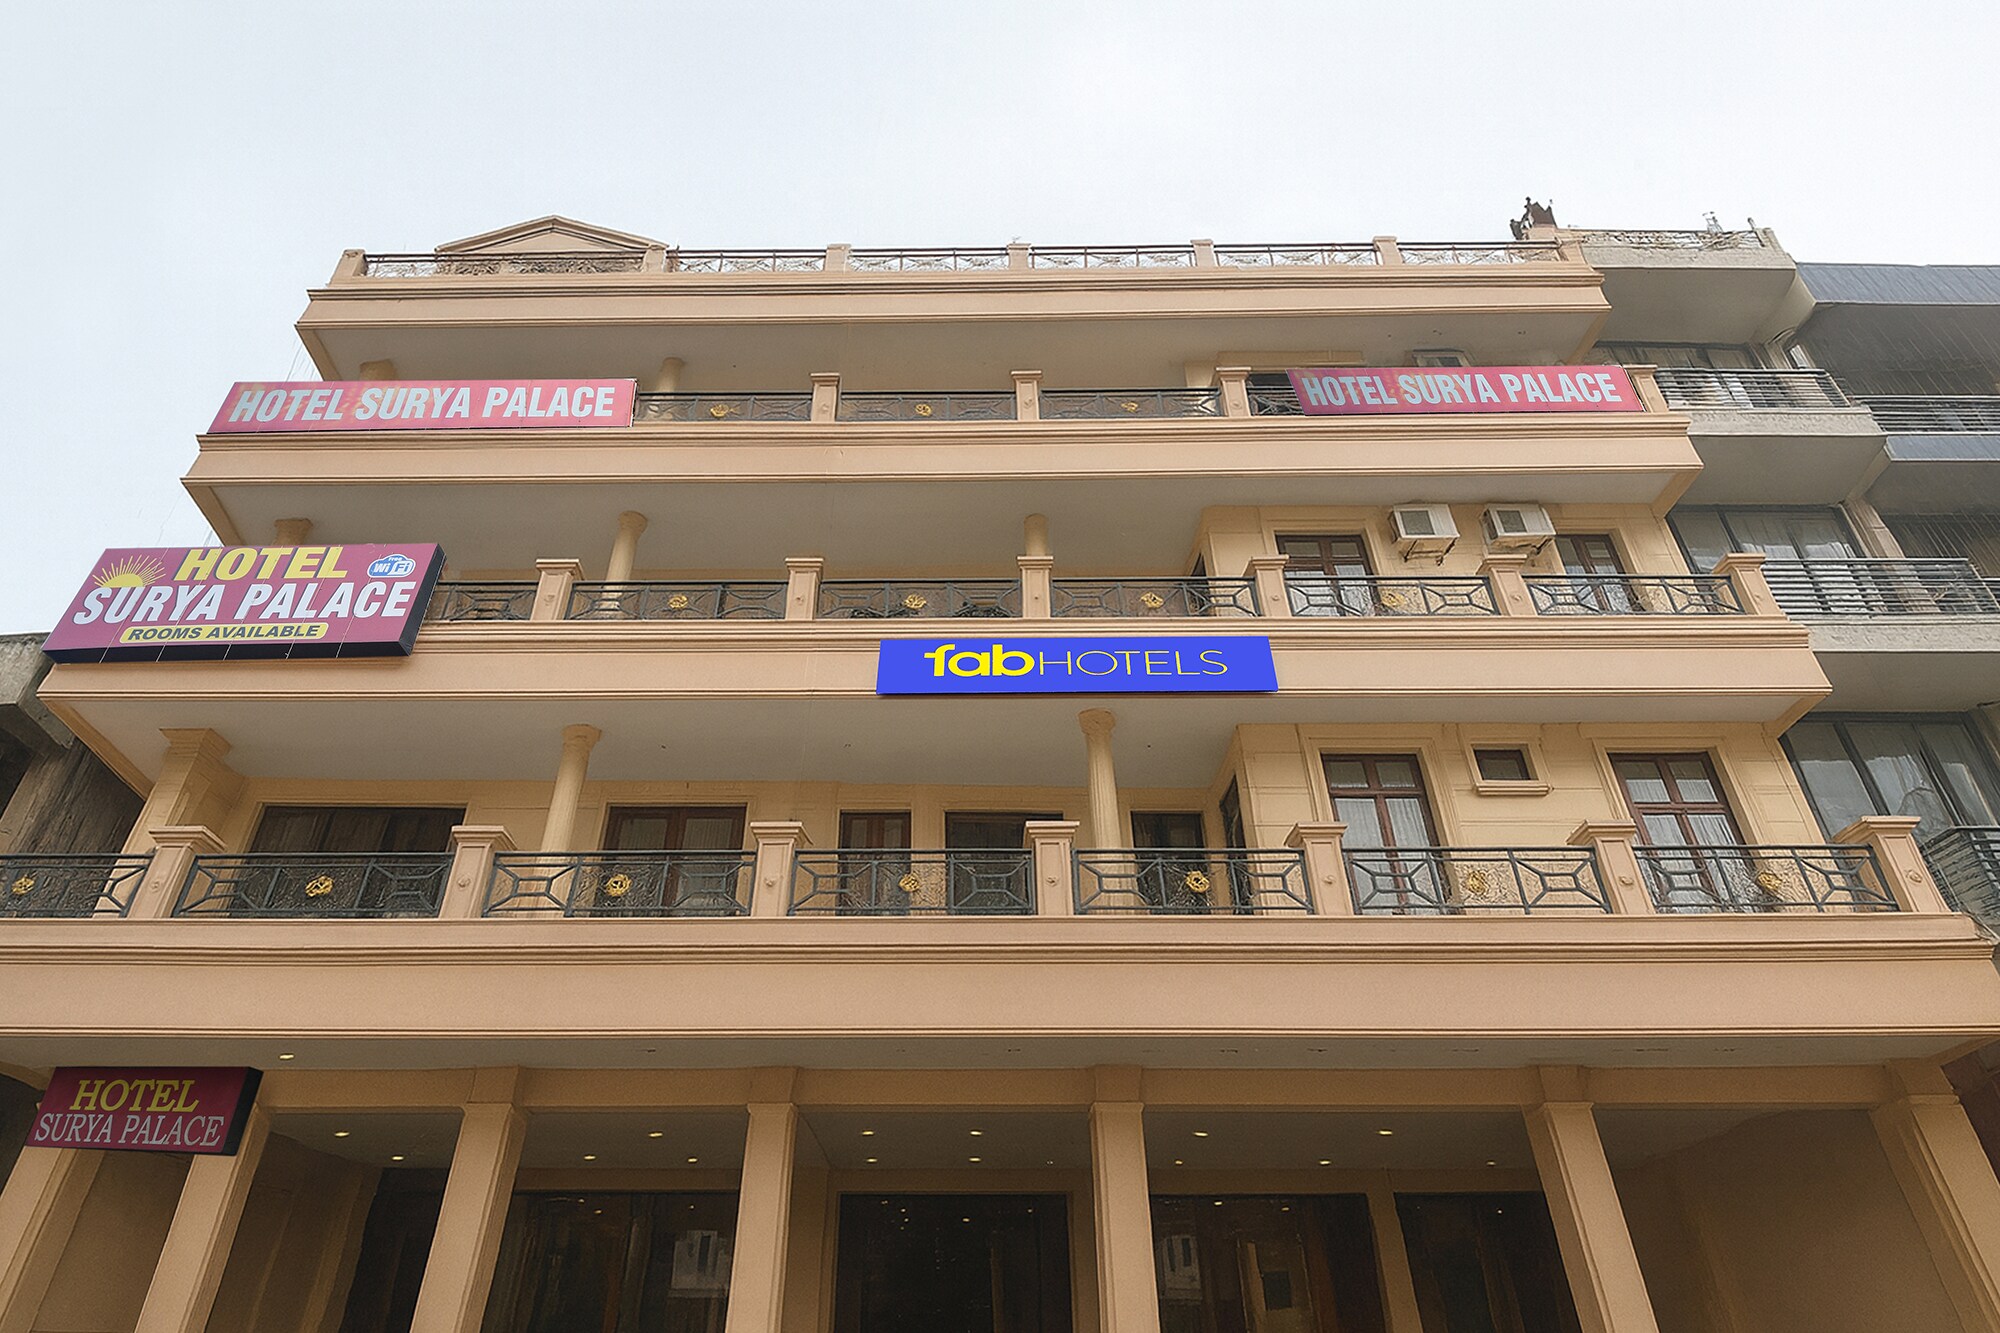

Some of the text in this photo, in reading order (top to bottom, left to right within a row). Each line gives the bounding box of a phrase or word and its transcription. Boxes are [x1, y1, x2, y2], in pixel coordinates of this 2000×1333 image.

[228, 386, 616, 422] HOTEL SURYA PALACE
[1301, 372, 1623, 407] HOTEL SURYA PALACE
[173, 546, 348, 582] HOTEL
[72, 581, 417, 625] SURYA PALACE
[127, 624, 321, 642] ROOMS AVAILABLE
[69, 1079, 200, 1113] HOTEL
[34, 1112, 225, 1147] SURYA PALACE
